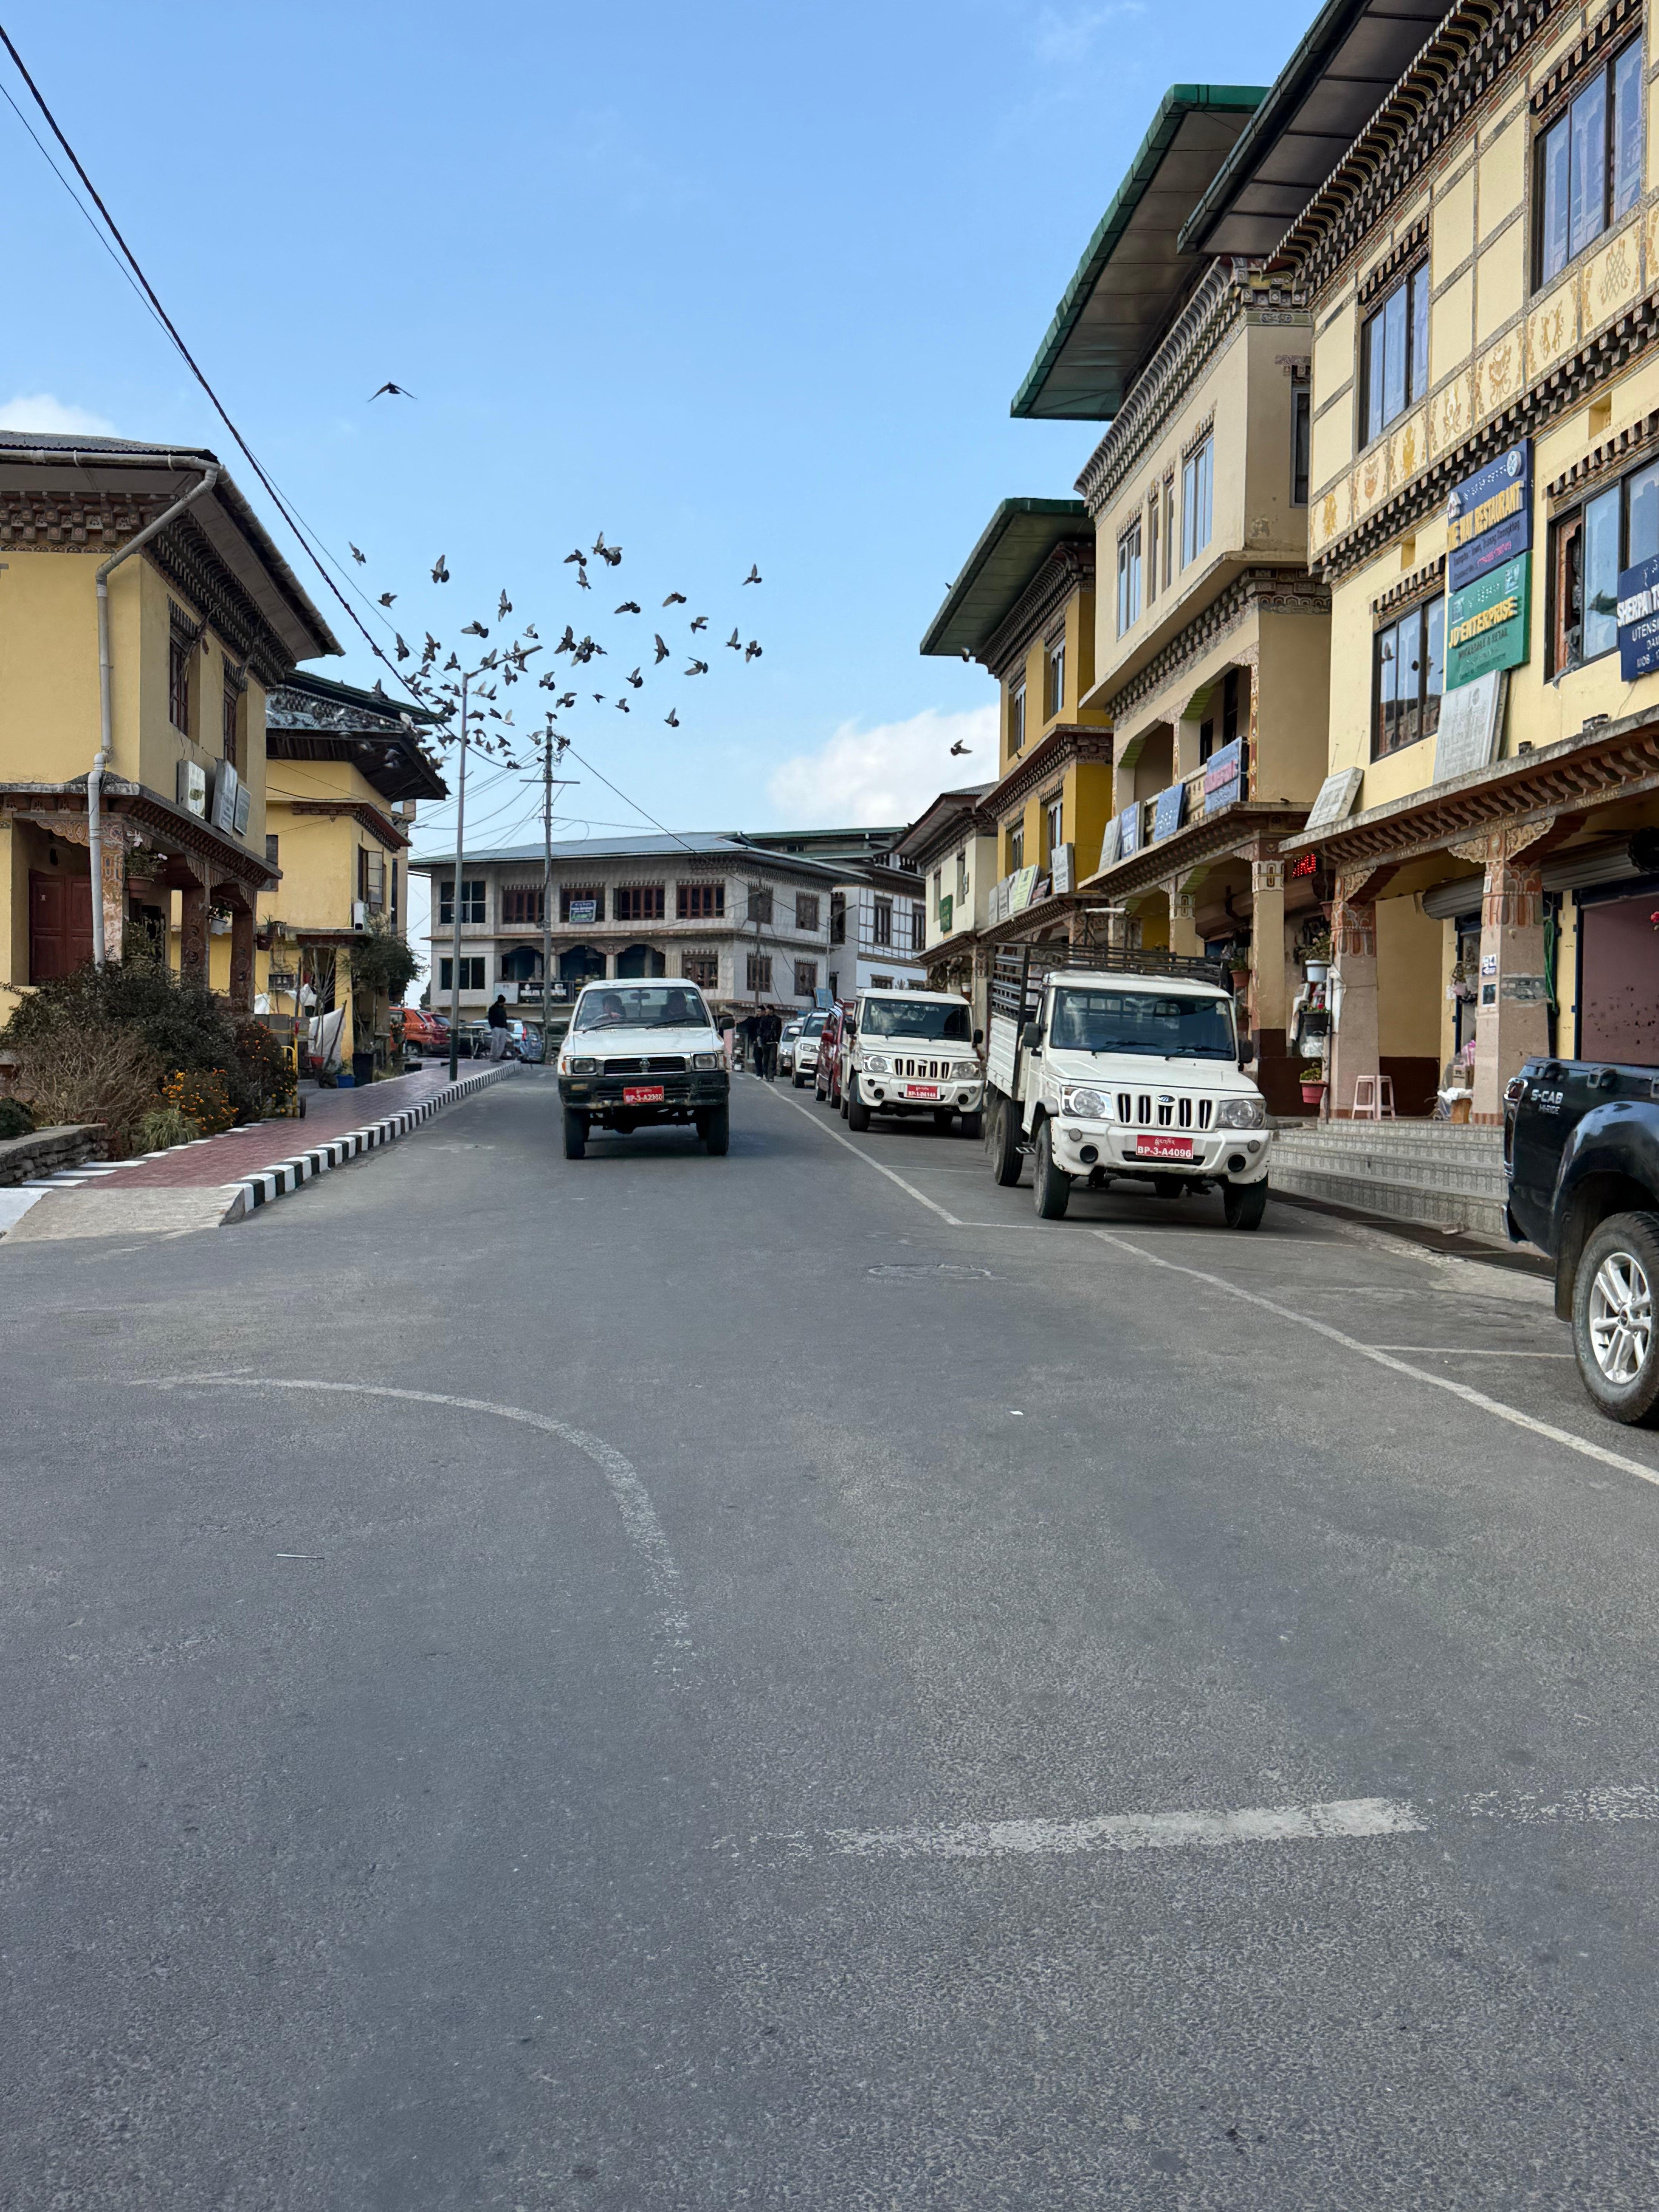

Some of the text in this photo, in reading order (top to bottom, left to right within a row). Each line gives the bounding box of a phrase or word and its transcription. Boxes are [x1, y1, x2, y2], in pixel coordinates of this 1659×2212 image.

[1475, 481, 1524, 535] RESTAURANT
[1461, 596, 1518, 642] ENTERPRISE
[1617, 591, 1652, 627] SHERPA
[1530, 1089, 1563, 1104] S-CAB
[1137, 1146, 1191, 1158] BP-3-A4096
